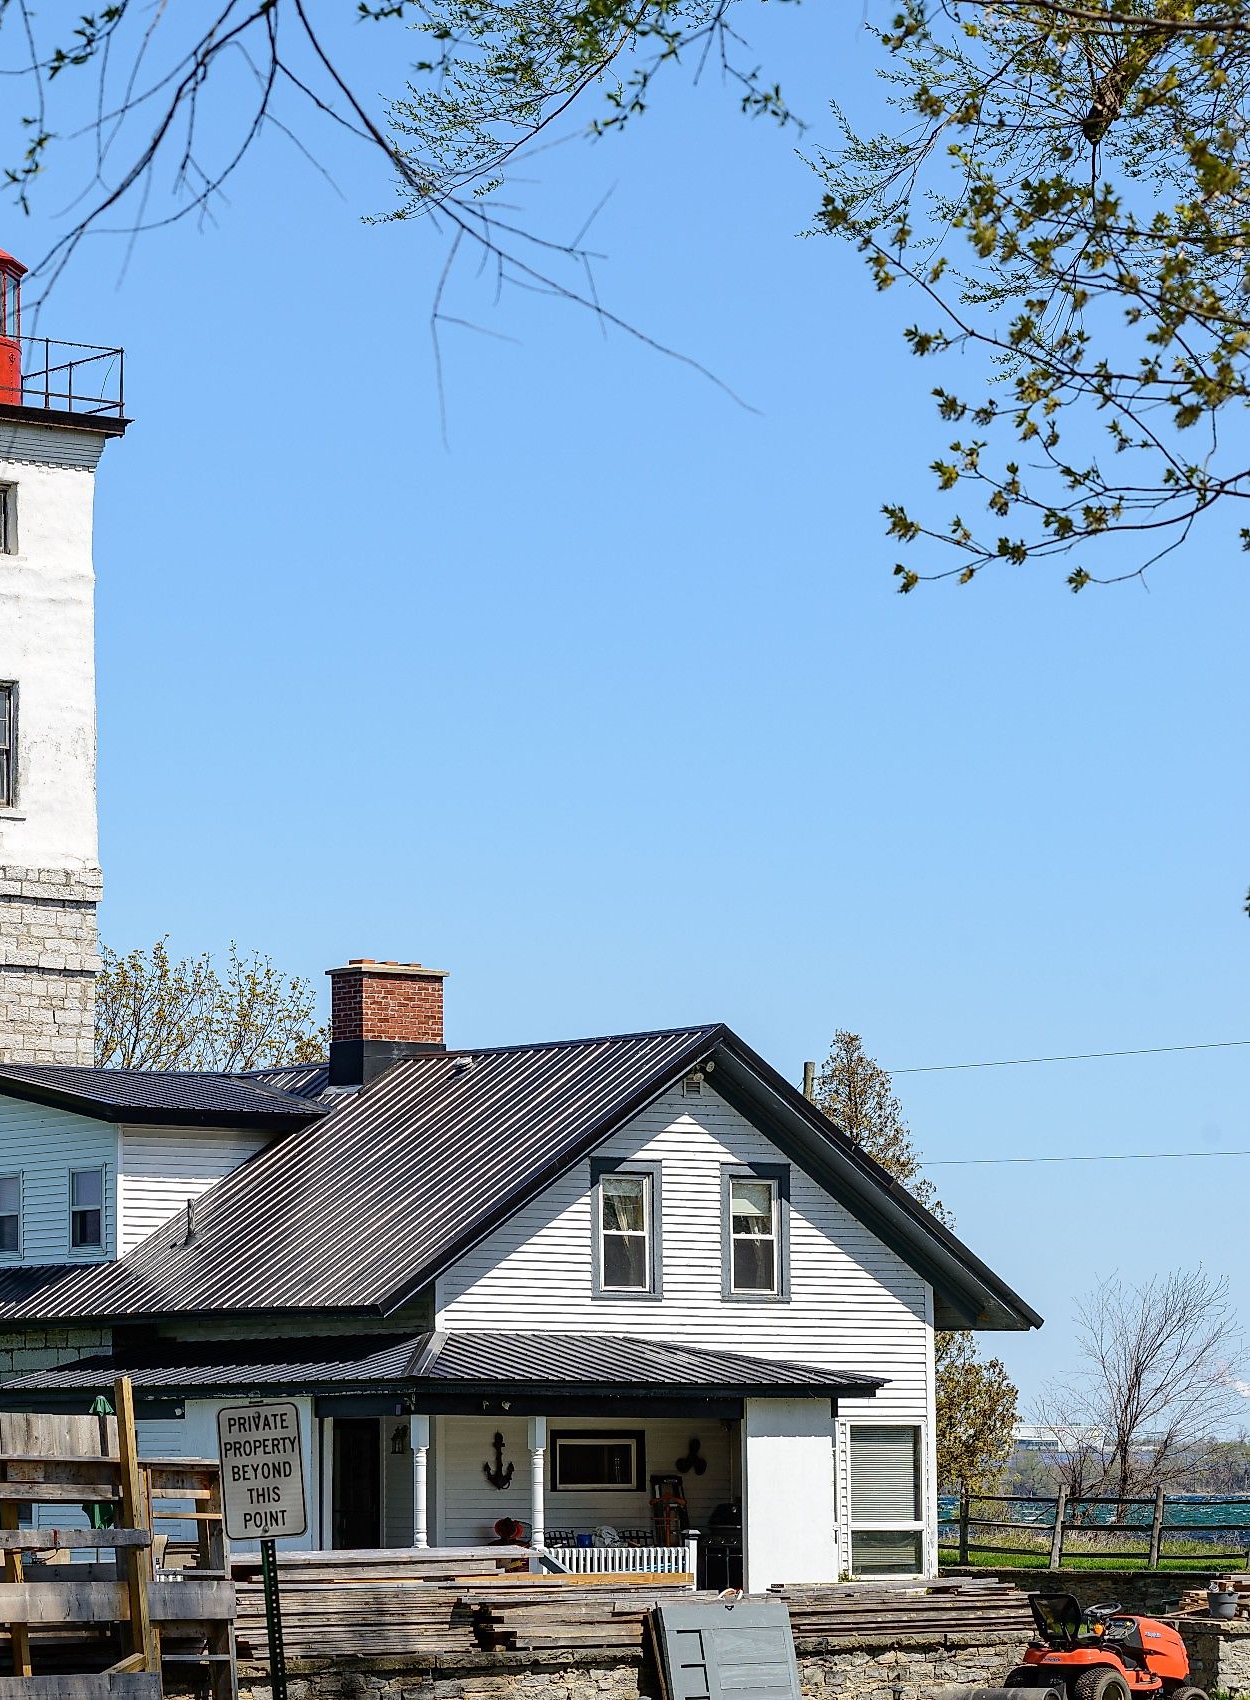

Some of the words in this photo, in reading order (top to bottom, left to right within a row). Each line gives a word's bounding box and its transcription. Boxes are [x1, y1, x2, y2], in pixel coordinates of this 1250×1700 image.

[228, 1413, 289, 1434] PRIVATE
[224, 1436, 297, 1458] PROPERTY
[232, 1461, 292, 1481] BEYOND
[247, 1486, 281, 1504] THIS
[243, 1510, 287, 1529] POINT
